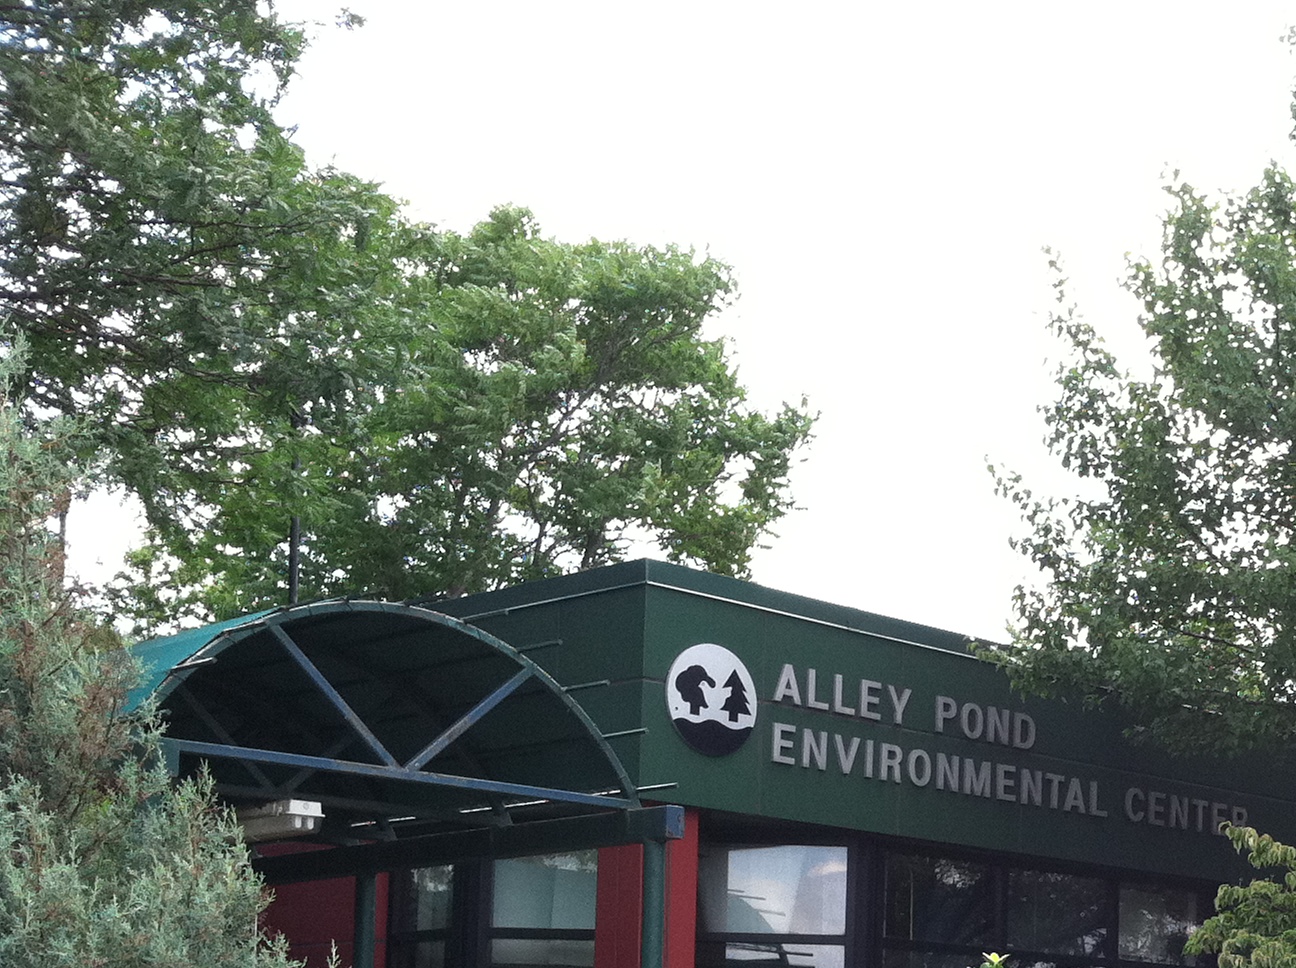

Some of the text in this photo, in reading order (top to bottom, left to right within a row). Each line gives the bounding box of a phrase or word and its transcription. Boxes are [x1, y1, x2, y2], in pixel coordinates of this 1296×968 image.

[774, 663, 1037, 750] ALLEY POND
[772, 722, 1249, 836] ENVIRONMENTAL CENTER
